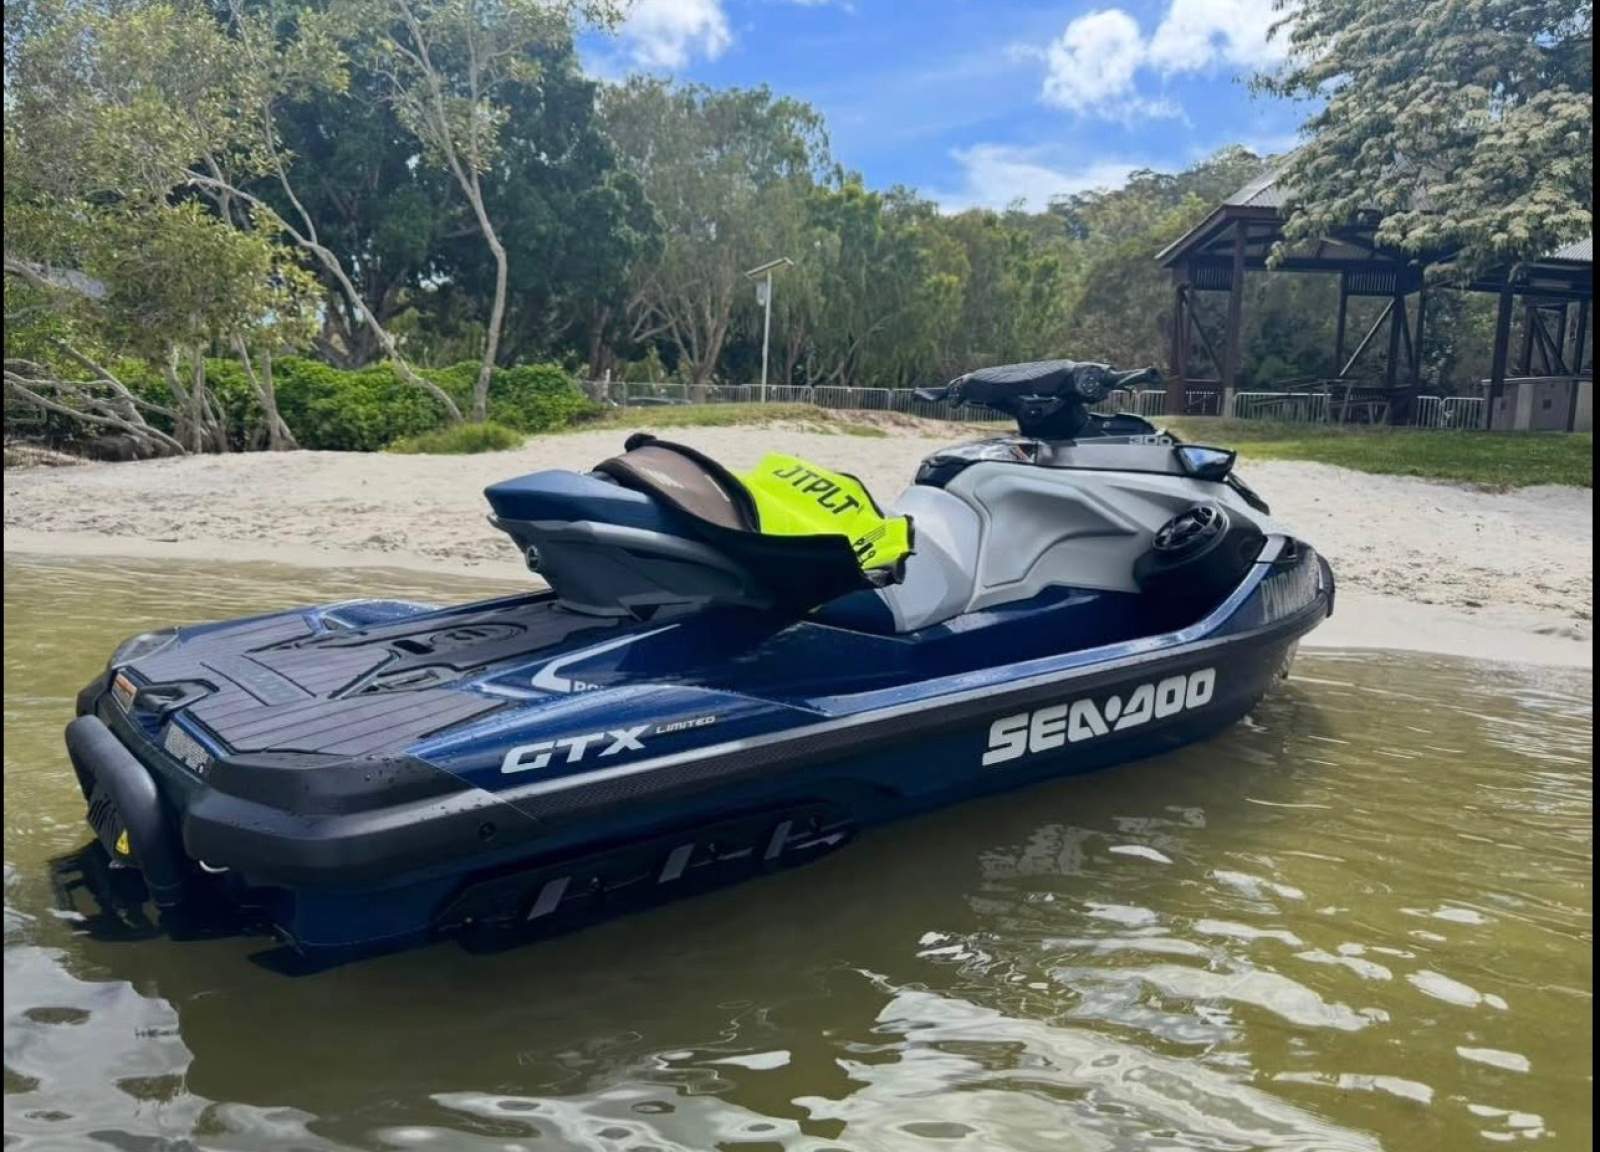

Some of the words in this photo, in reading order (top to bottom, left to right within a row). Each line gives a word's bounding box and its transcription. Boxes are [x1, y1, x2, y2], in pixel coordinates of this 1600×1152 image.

[1129, 434, 1173, 446] 300
[773, 465, 860, 514] JTPLT
[500, 724, 651, 774] GTX
[655, 715, 716, 734] LIMITED
